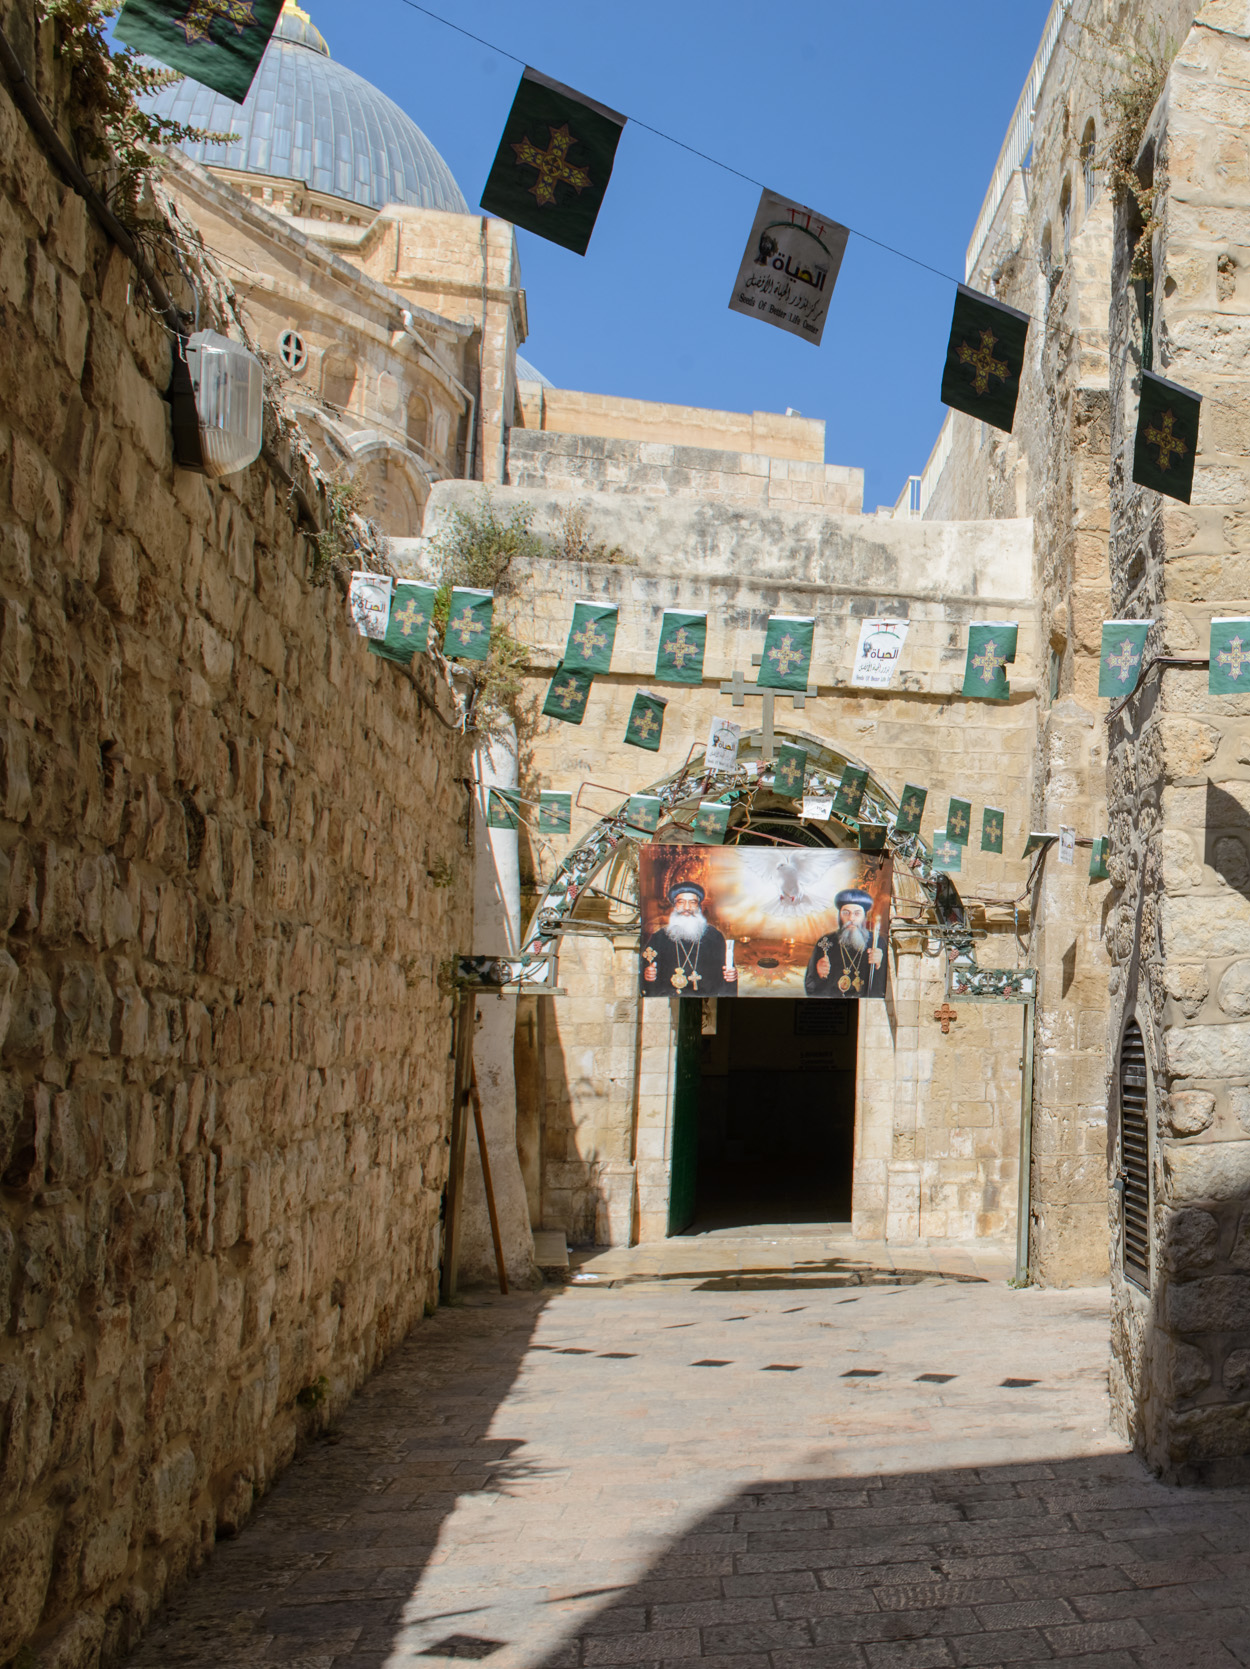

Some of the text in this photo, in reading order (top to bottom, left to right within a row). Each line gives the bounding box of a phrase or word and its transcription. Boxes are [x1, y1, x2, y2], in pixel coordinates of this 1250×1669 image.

[772, 252, 827, 292] الحياة
[757, 299, 768, 311] Of
[870, 648, 899, 661] الحياة
